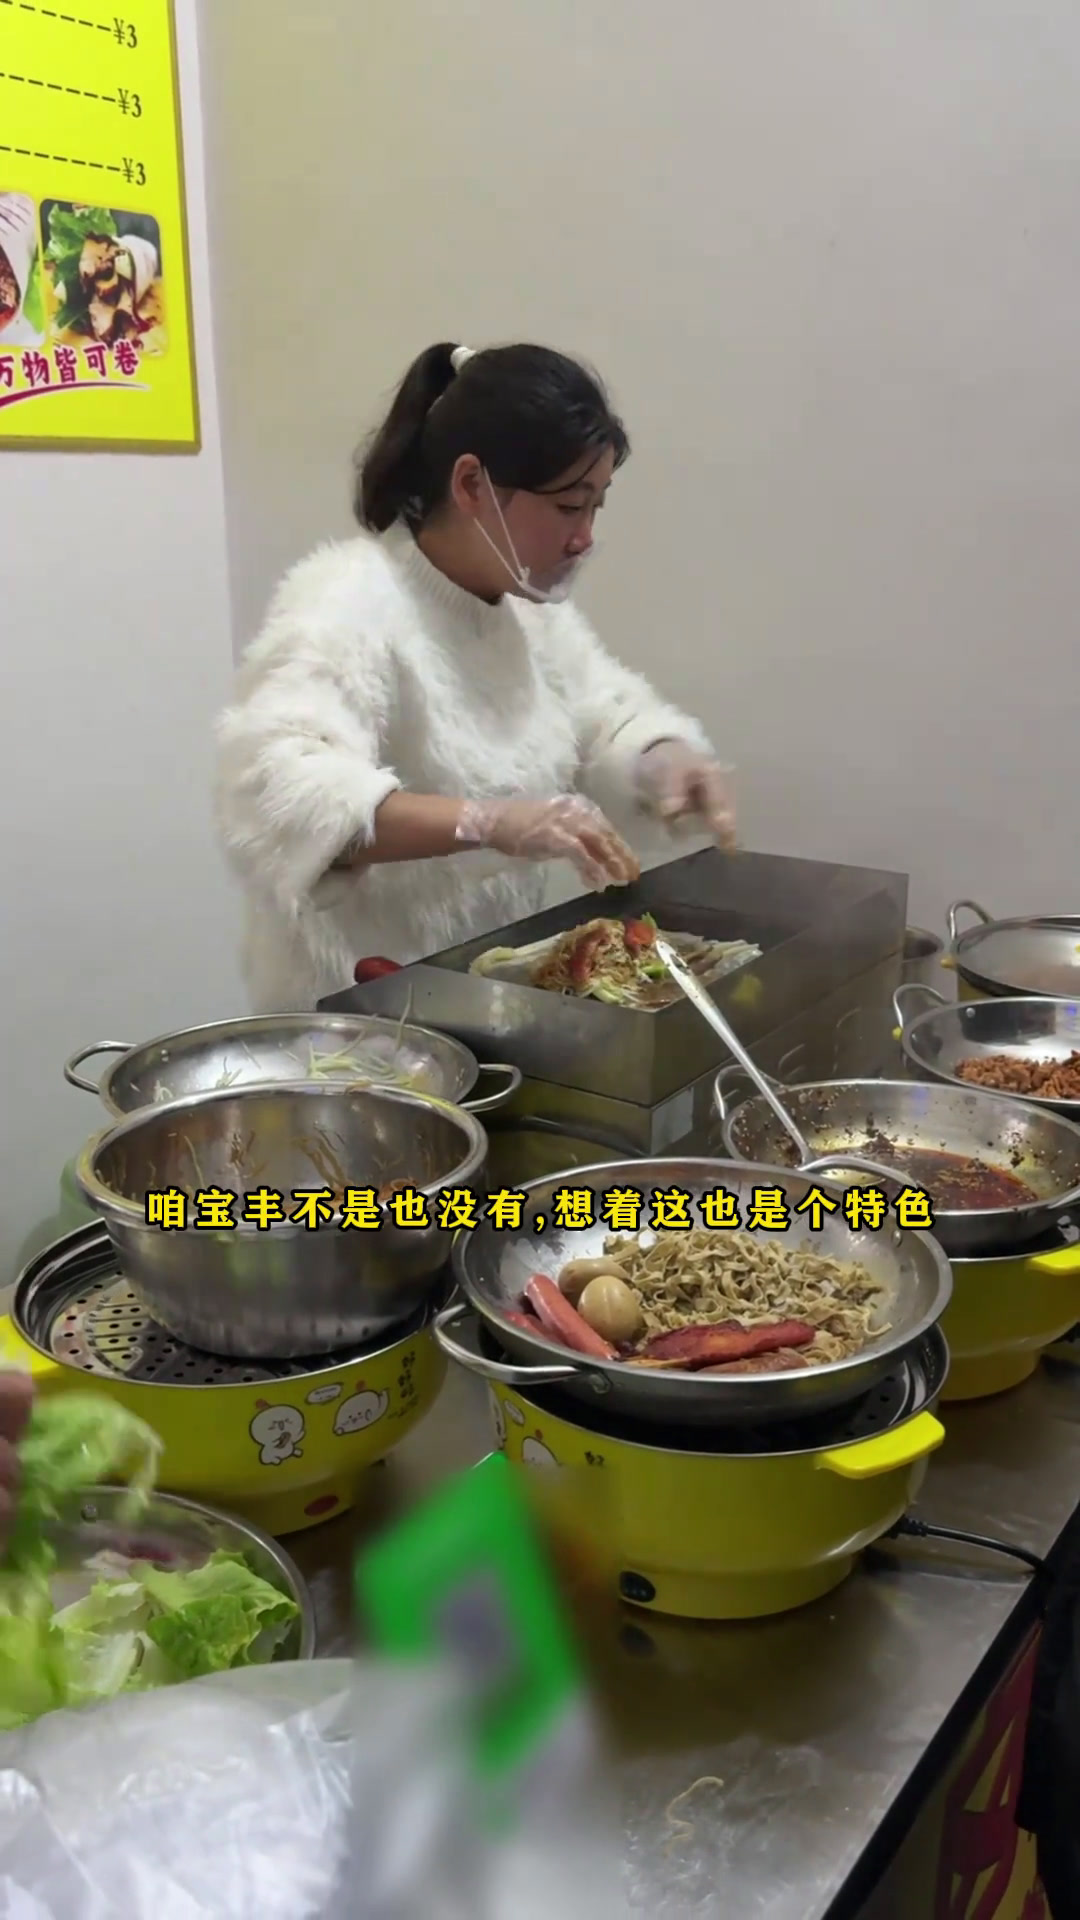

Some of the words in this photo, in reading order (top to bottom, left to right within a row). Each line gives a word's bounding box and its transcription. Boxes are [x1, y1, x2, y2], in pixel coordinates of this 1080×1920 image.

[113, 18, 138, 48] ¥3
[118, 88, 142, 118] ¥3
[122, 157, 146, 186] ¥3
[0, 341, 138, 388] 万物皆可卷
